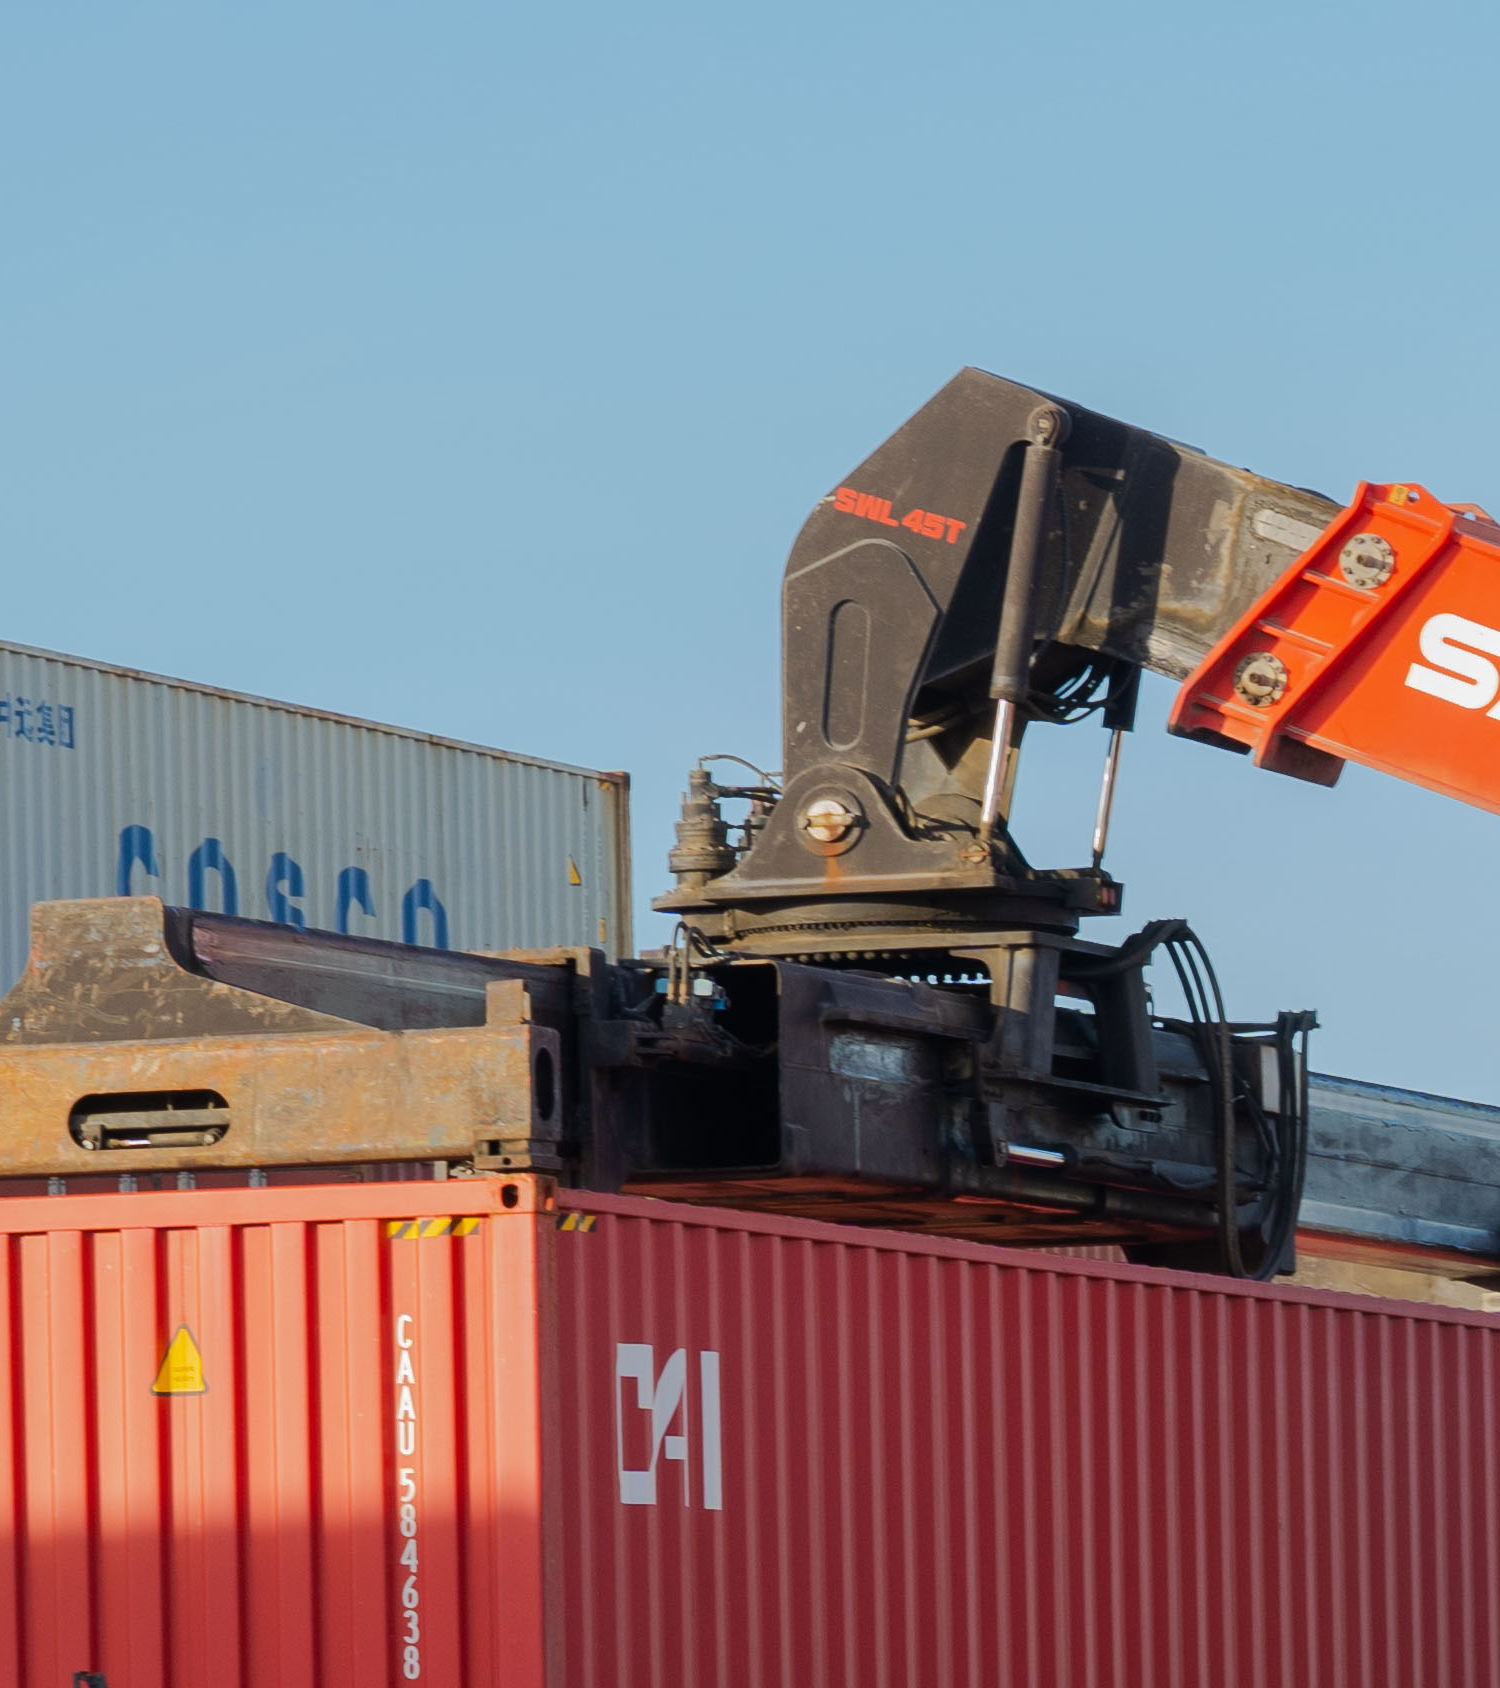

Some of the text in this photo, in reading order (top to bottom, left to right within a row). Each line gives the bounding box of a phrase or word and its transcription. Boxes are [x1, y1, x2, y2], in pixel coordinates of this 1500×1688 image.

[833, 487, 967, 546] SWL 45T
[118, 823, 449, 950] COSCO
[396, 1314, 417, 1456] CAAU
[615, 1341, 723, 1512] CAI
[398, 1467, 422, 1681] 584638
